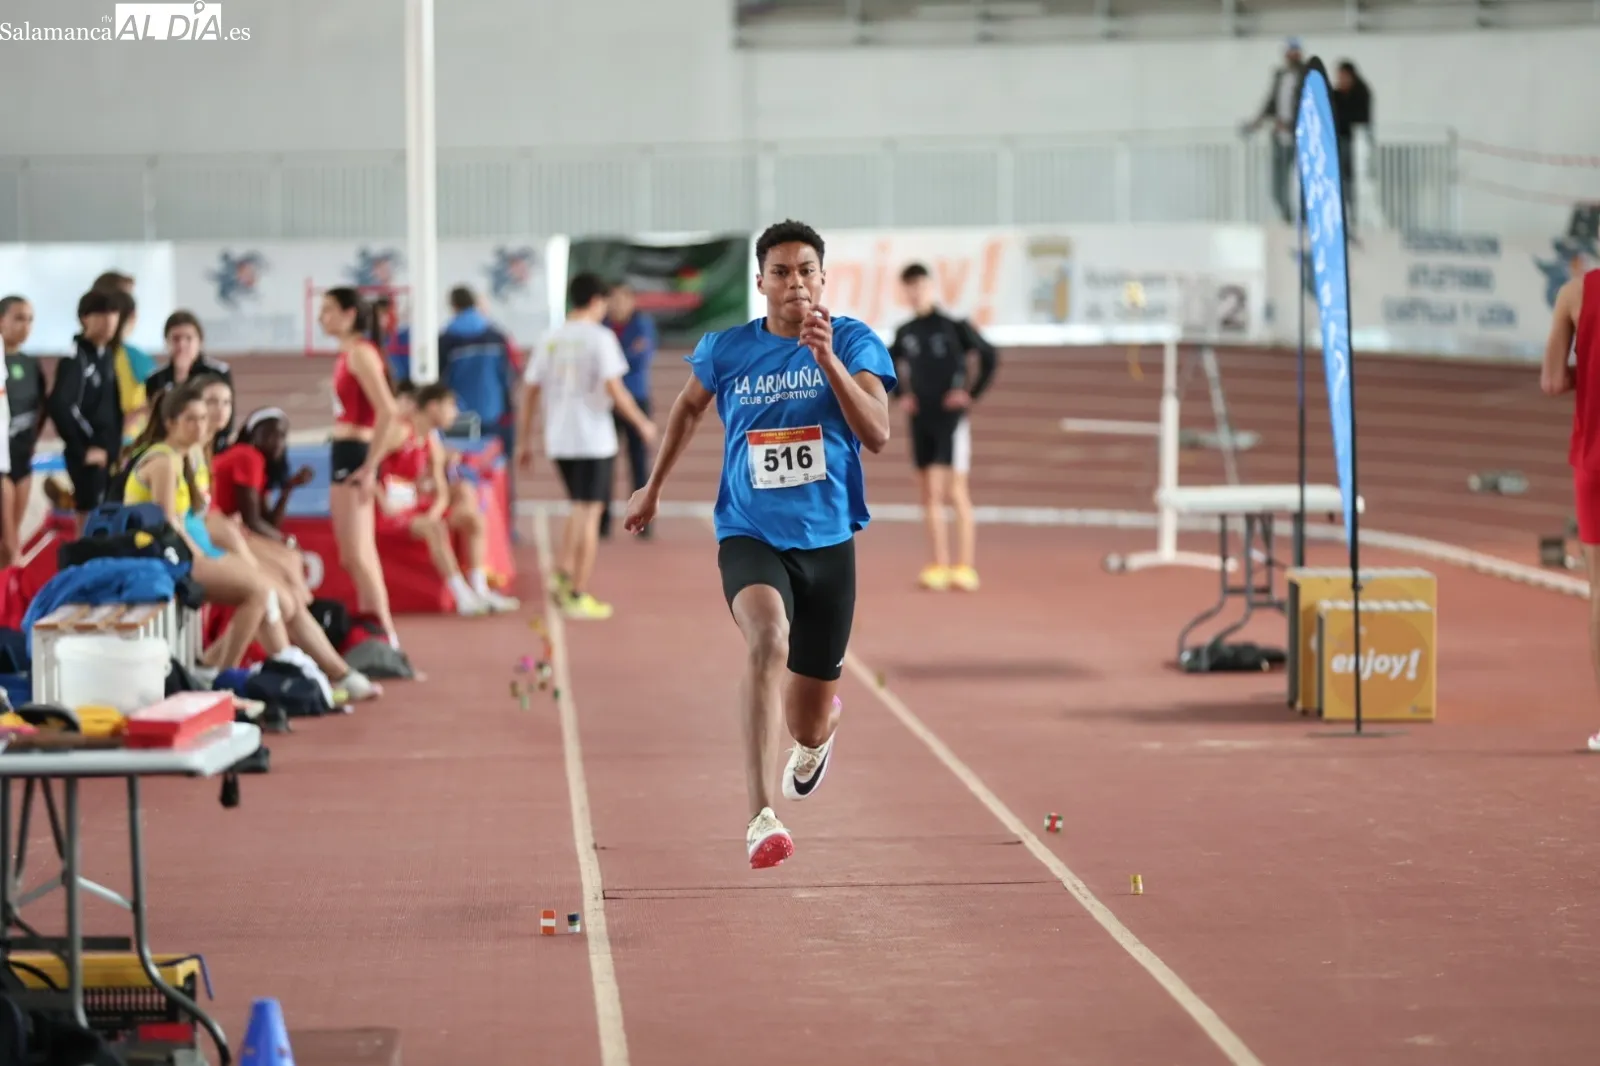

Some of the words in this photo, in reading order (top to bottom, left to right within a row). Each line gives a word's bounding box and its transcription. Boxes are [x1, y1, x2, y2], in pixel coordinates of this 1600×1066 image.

[1217, 285, 1247, 331] 2
[735, 375, 751, 394] LA
[755, 365, 824, 393] ARMUÑA
[740, 396, 761, 405] CLUB
[765, 389, 817, 404] DEPORTIVO
[764, 445, 813, 472] 516
[1331, 648, 1420, 681] enjoy!
